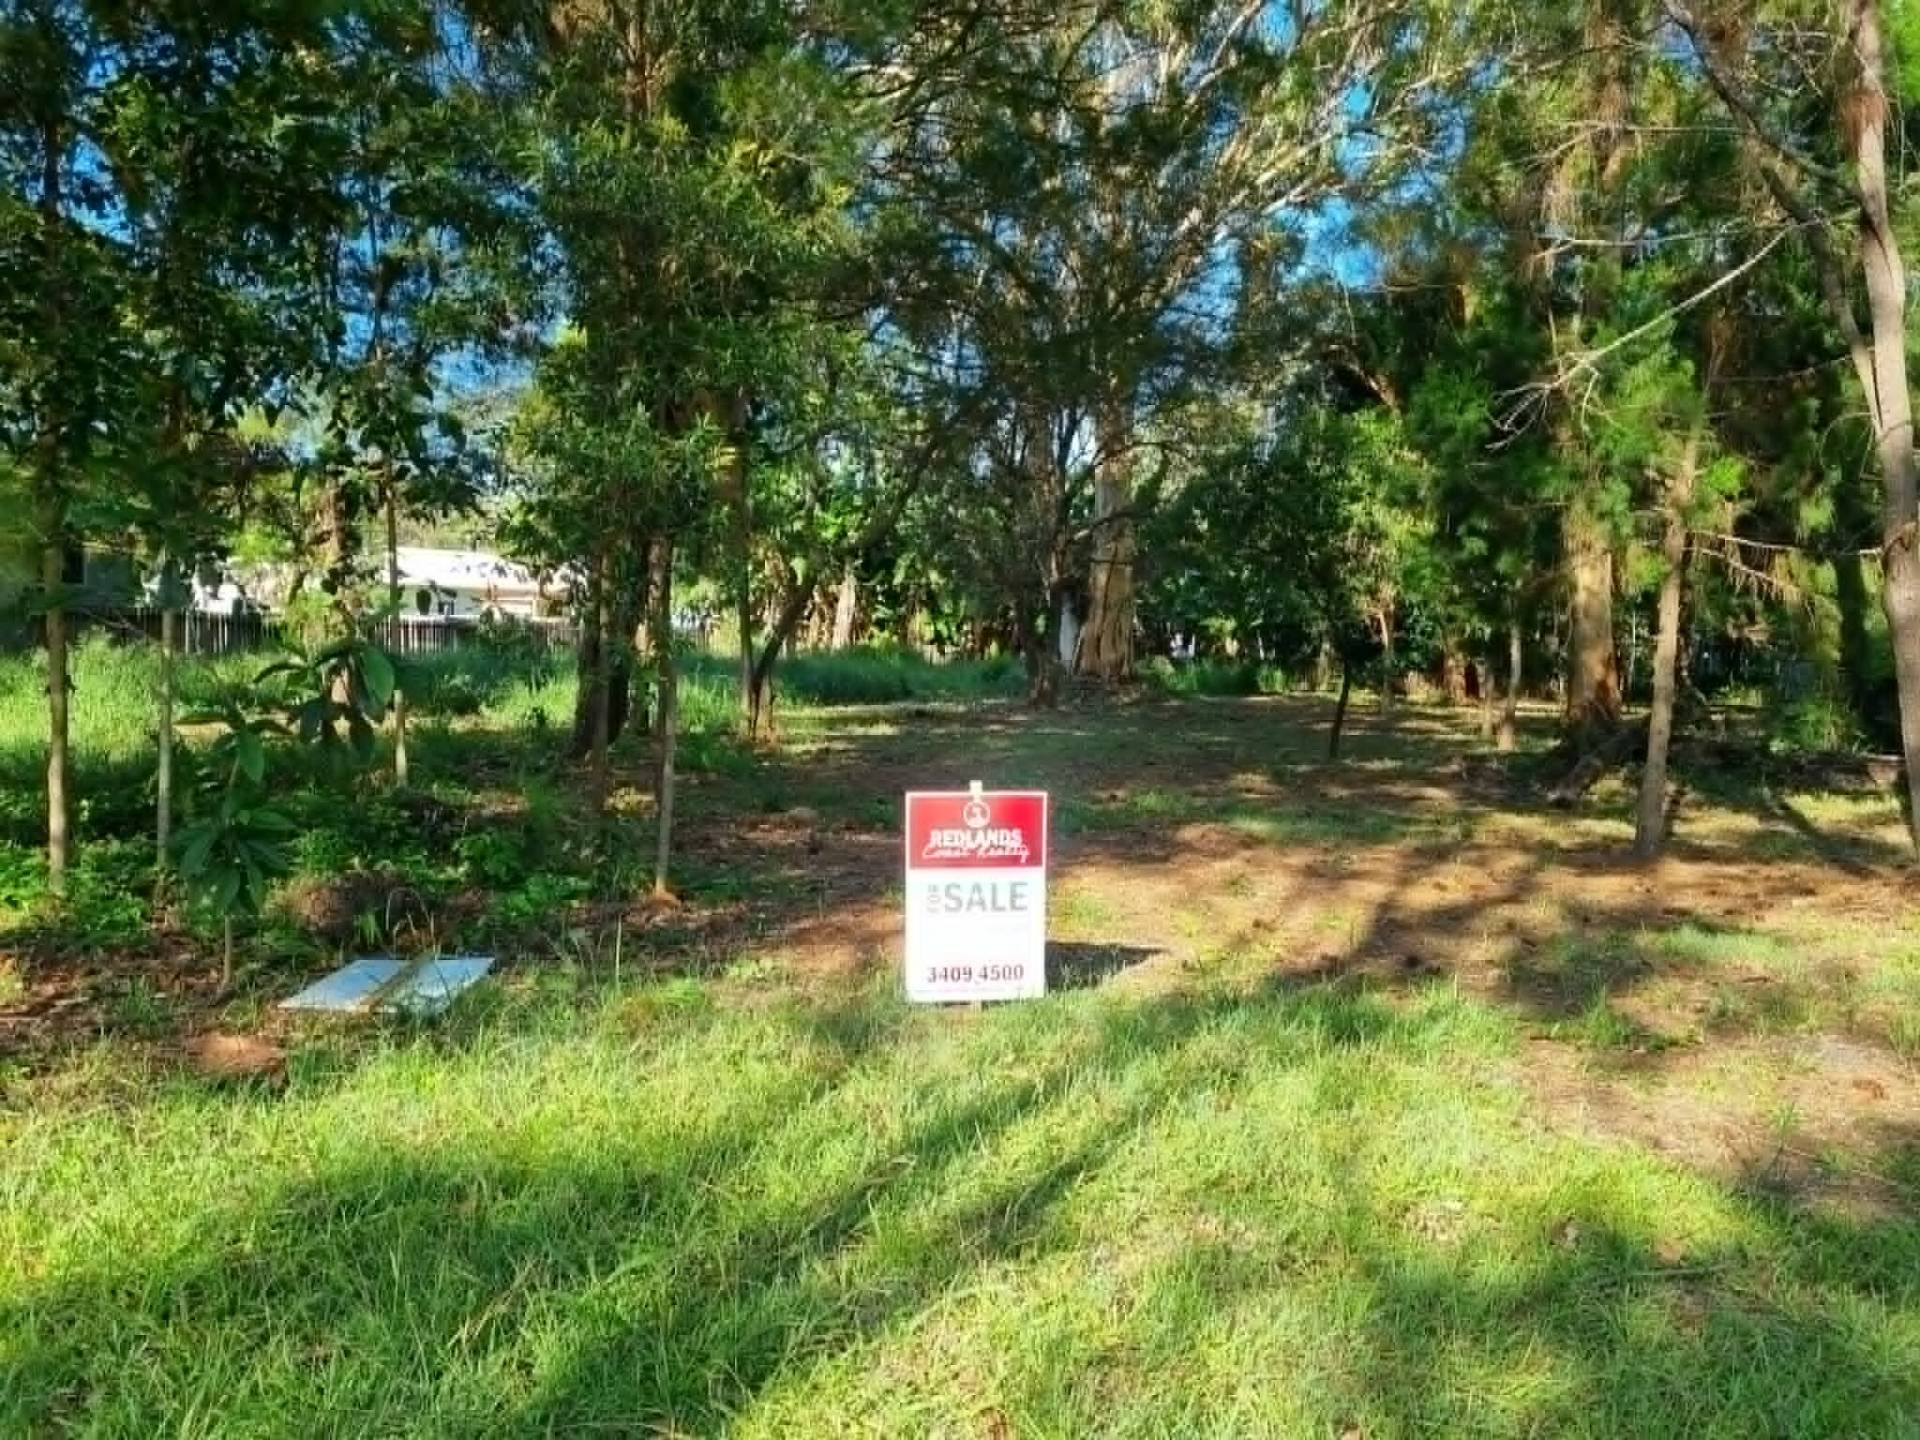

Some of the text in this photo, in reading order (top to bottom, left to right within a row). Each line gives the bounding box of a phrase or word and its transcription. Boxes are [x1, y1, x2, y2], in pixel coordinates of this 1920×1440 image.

[930, 828, 1023, 850] REDLANDS
[944, 880, 1028, 913] SALE
[926, 963, 1025, 984] 3409 4500
